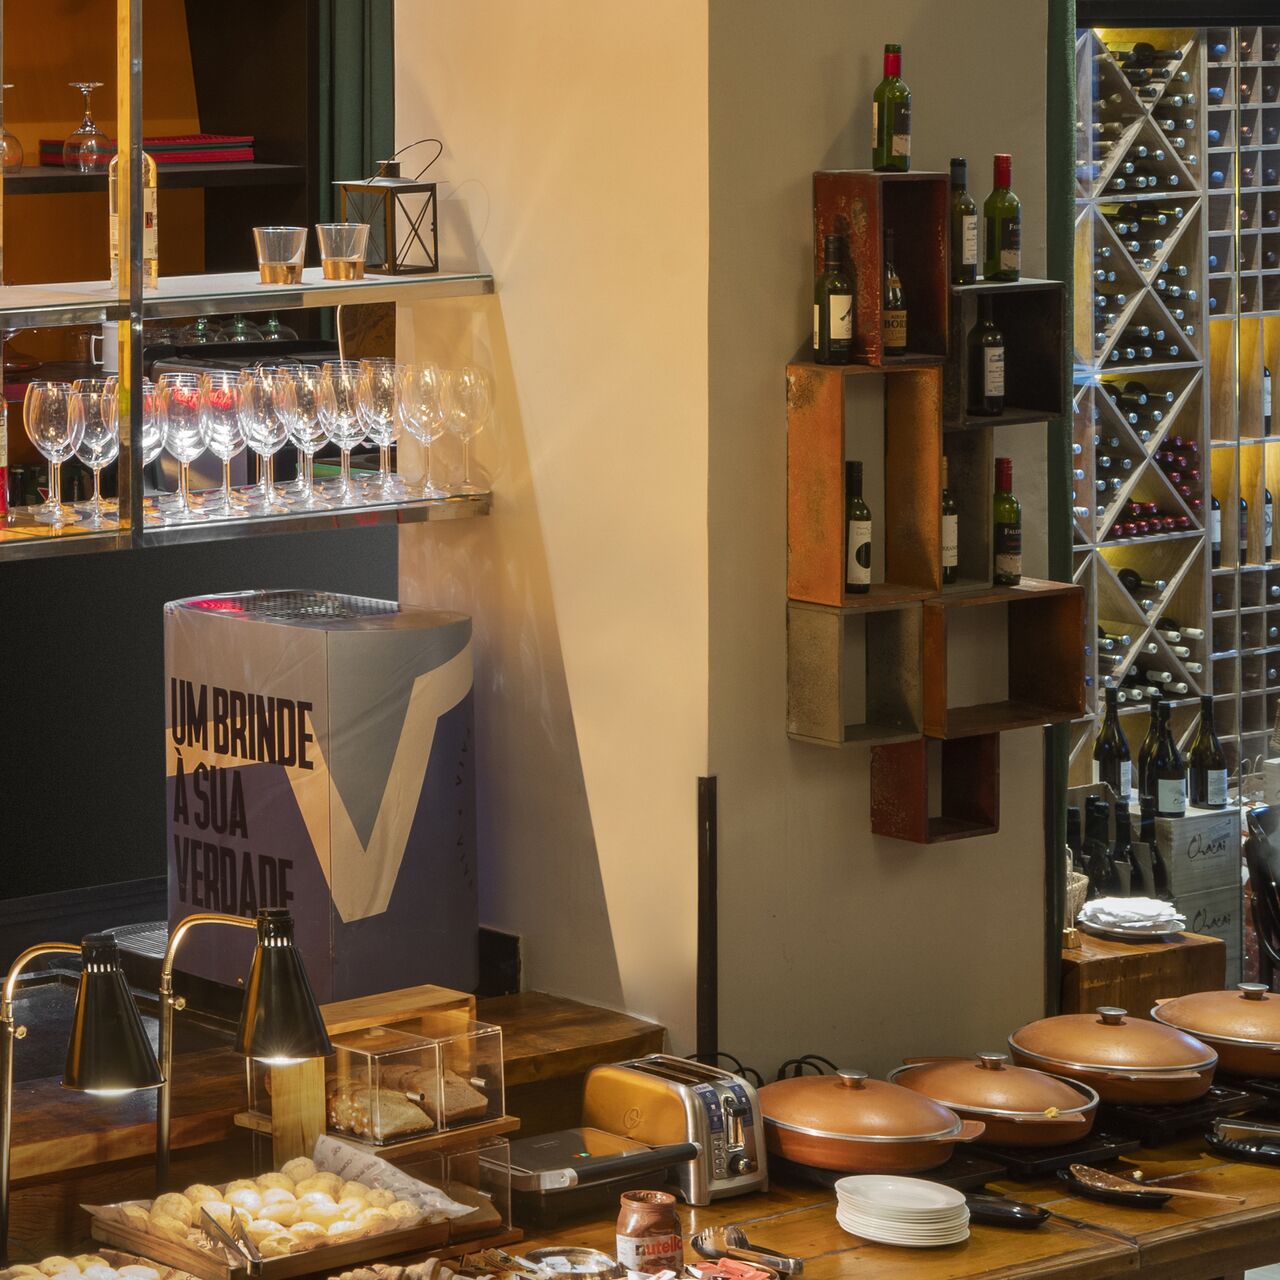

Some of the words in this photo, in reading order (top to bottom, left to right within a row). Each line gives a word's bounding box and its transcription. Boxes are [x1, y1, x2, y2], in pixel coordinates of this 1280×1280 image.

[171, 677, 208, 751] UM
[212, 686, 314, 770] BRINDE
[173, 747, 190, 825] À
[193, 761, 248, 839] SUA
[173, 834, 294, 918] VERDADE
[635, 1236, 683, 1256] nutella
